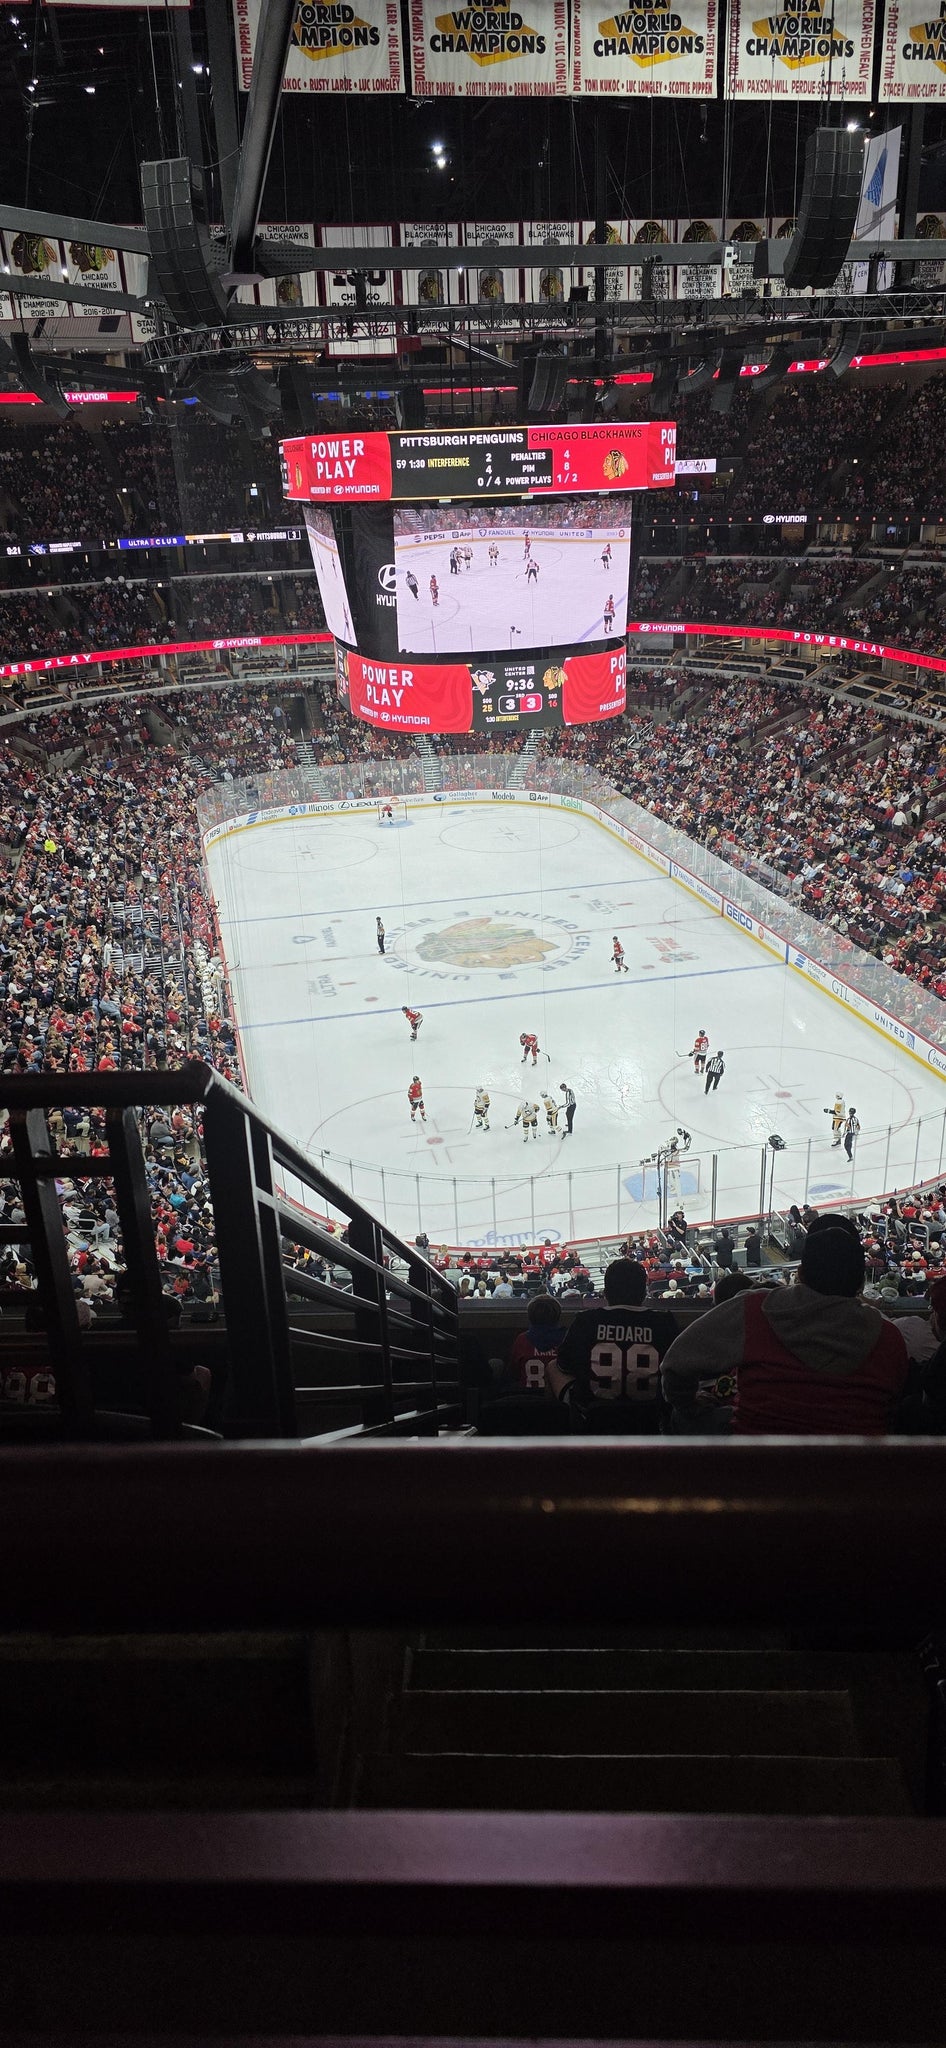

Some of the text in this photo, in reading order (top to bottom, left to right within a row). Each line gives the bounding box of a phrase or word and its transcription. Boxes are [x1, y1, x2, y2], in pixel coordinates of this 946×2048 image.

[784, 0, 821, 13] NBA
[296, 4, 355, 24] ORLD
[386, 3, 397, 25] KERR
[451, 12, 523, 31] WORLD
[614, 14, 682, 33] WORLD
[768, 17, 835, 35] WORLD
[238, 23, 250, 54] PIPPEN
[387, 34, 398, 48] JOE
[411, 0, 426, 81] DICKEY SIMPKIN
[430, 34, 546, 54] CHAMPIONS
[704, 0, 716, 79] ORDAN STEVE KERR
[860, 37, 872, 49] ED
[883, 7, 899, 80] WILL PERDUE
[554, 2, 567, 95] KUKOC LUC LONGLEY
[593, 35, 704, 57] CHAMPIONS
[746, 38, 854, 58] CHAMPIONS
[573, 17, 581, 92] DENNIS RODMAN
[859, 50, 871, 80] NEALY
[282, 78, 400, 91] UKOC RUSTY LARUE LUC LONGLEY
[415, 81, 556, 95] ROBERT PARISH SCOTTIE PIPPEN DENNIS RODMAN
[600, 79, 620, 92] KUKOC
[626, 80, 638, 92] LUC
[638, 81, 663, 94] LONGLEY
[669, 81, 690, 94] SCOTTIE
[691, 81, 713, 95] PIPPEN
[728, 79, 744, 93] JOHN
[747, 80, 772, 94] PAXSON
[774, 80, 788, 94] WILL
[791, 80, 816, 94] PERDUE
[845, 81, 867, 95] PIPPEN
[883, 83, 905, 97] STACEY
[907, 84, 921, 97] KING
[267, 225, 300, 233] CHICAGO
[405, 231, 453, 239] BLACKHAWKS
[260, 232, 309, 240] BLACKHAWKS
[341, 293, 380, 301] CHIGO
[84, 308, 116, 316] 2016-2017
[72, 392, 108, 400] HYUNDAI
[400, 433, 524, 447] PITTSBURGH PENGUINS
[531, 429, 643, 442] CHICAGO BLACKHAWKS
[311, 439, 365, 459] POWER
[563, 450, 570, 458] 4
[396, 457, 470, 469] 59 1:30 INTERFERENCE
[485, 453, 492, 462] 2
[511, 452, 546, 461] PENALTIES
[317, 459, 356, 480] PLAY
[485, 465, 492, 474] 4
[522, 464, 535, 473] PIM
[564, 462, 570, 470] 8
[505, 475, 552, 485] POWER PLAYS
[344, 485, 380, 493] HYUNDAI
[775, 515, 807, 523] HYUNDAI
[155, 537, 178, 545] CLUB
[256, 532, 287, 540] PITTSBURGH
[423, 533, 446, 542] PEPSI
[652, 624, 885, 655] HYUNDAI POWER PLAY
[45, 638, 262, 668] PLAY HYUNDAI
[362, 664, 414, 687] POWER
[506, 679, 535, 691] 9:36
[367, 684, 404, 707] PLAY
[482, 705, 493, 713] 25
[505, 698, 516, 710] 3
[526, 697, 536, 708] 3
[548, 700, 558, 708] 16
[392, 713, 430, 725] HYUNDAI
[491, 791, 515, 800] Modelo
[308, 803, 335, 812] Illinois
[350, 800, 383, 808] LEXUS
[560, 796, 583, 810] Kalshi
[260, 807, 285, 816] Endeavor
[261, 814, 278, 822] Health
[209, 828, 221, 838] PEPSI
[726, 903, 753, 931] GEICO
[495, 910, 591, 972] UNITED CENTER
[383, 957, 471, 982] UNITED
[831, 979, 850, 1003] GTL
[874, 1011, 905, 1039] UNITED
[597, 1325, 653, 1343] BEDARD
[590, 1342, 660, 1399] 98
